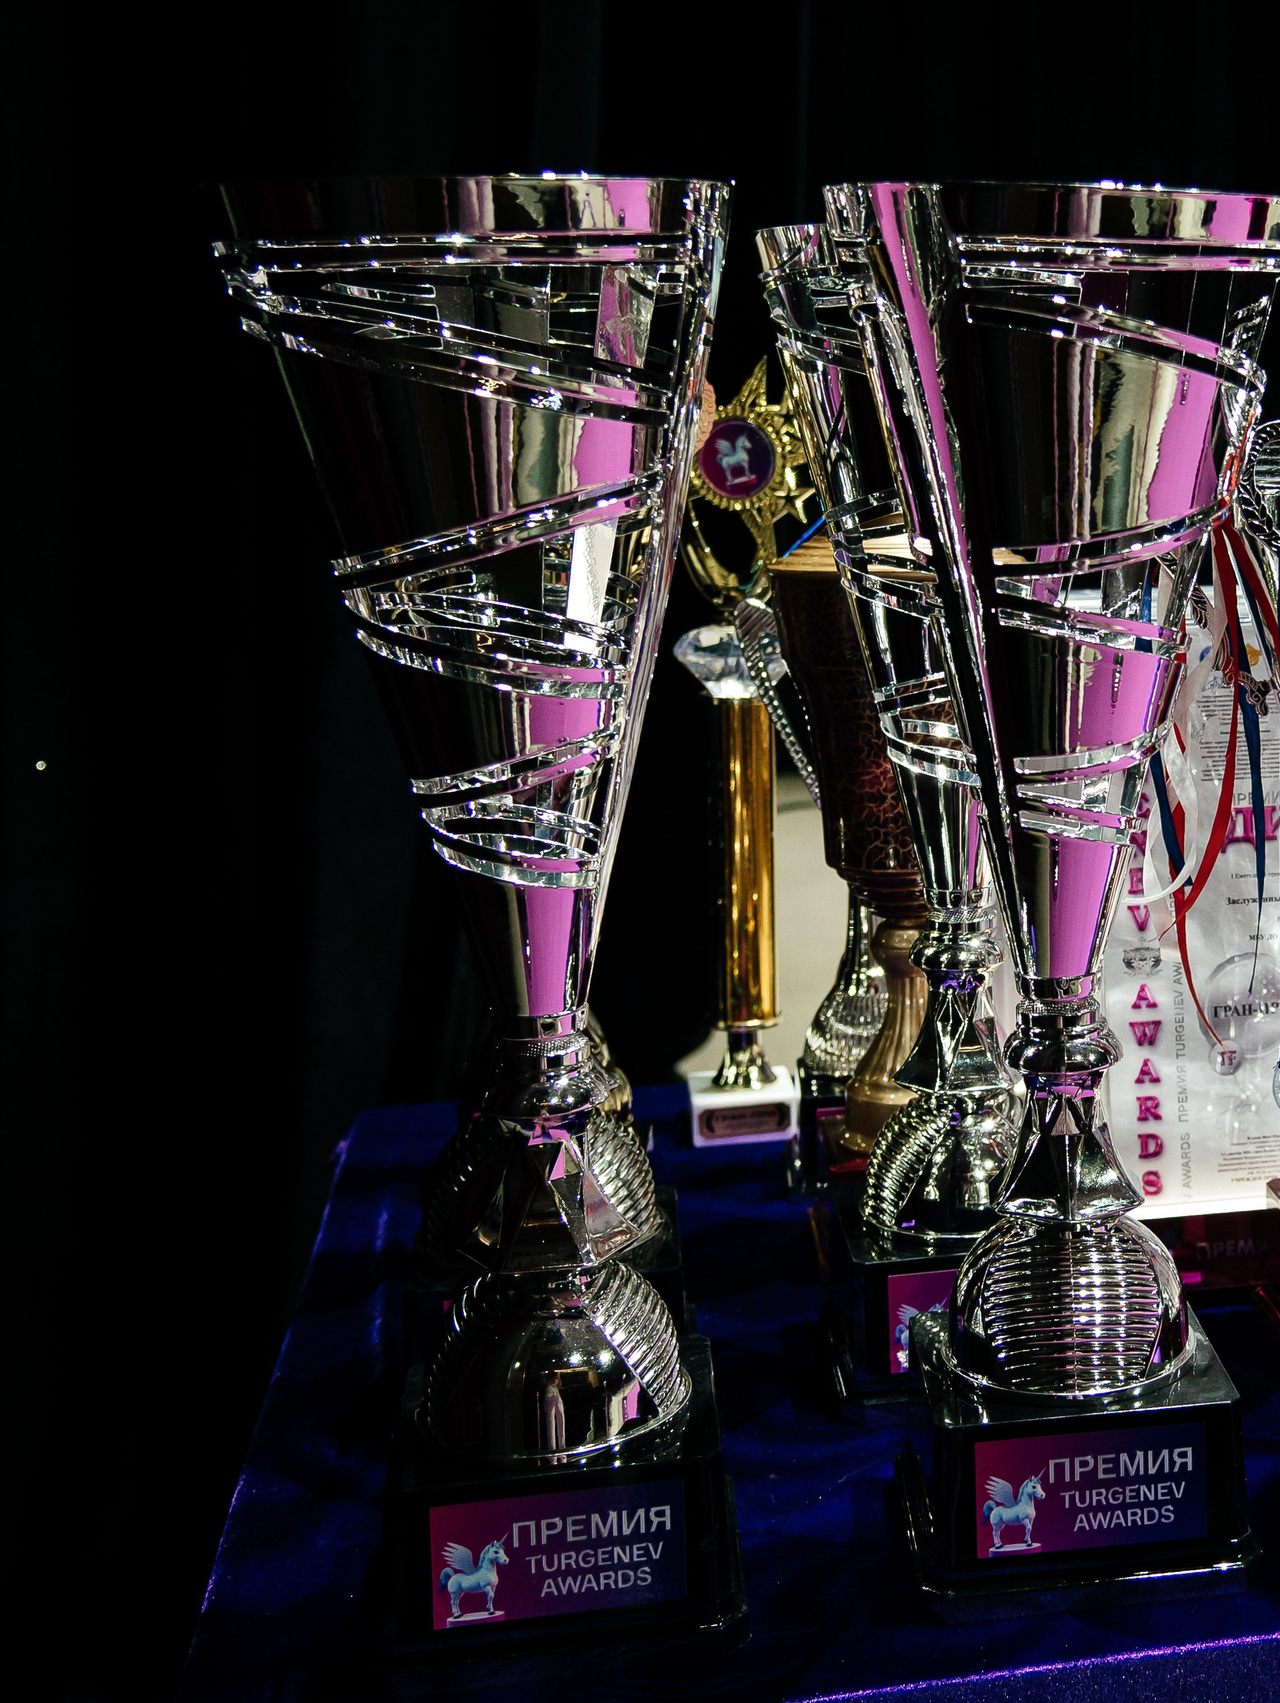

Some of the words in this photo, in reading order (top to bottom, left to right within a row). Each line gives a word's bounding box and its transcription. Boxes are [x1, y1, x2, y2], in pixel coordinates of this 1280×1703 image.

[1129, 983, 1165, 1197] AWARDS
[1047, 1446, 1195, 1484] ПРЕМИЯ
[1060, 1481, 1186, 1509] TURGENEV
[512, 1505, 672, 1548] ПРЕМИЯ
[1073, 1505, 1176, 1532] AWARDS
[525, 1541, 664, 1574] TURGENEV
[540, 1566, 652, 1598] AWARDS
